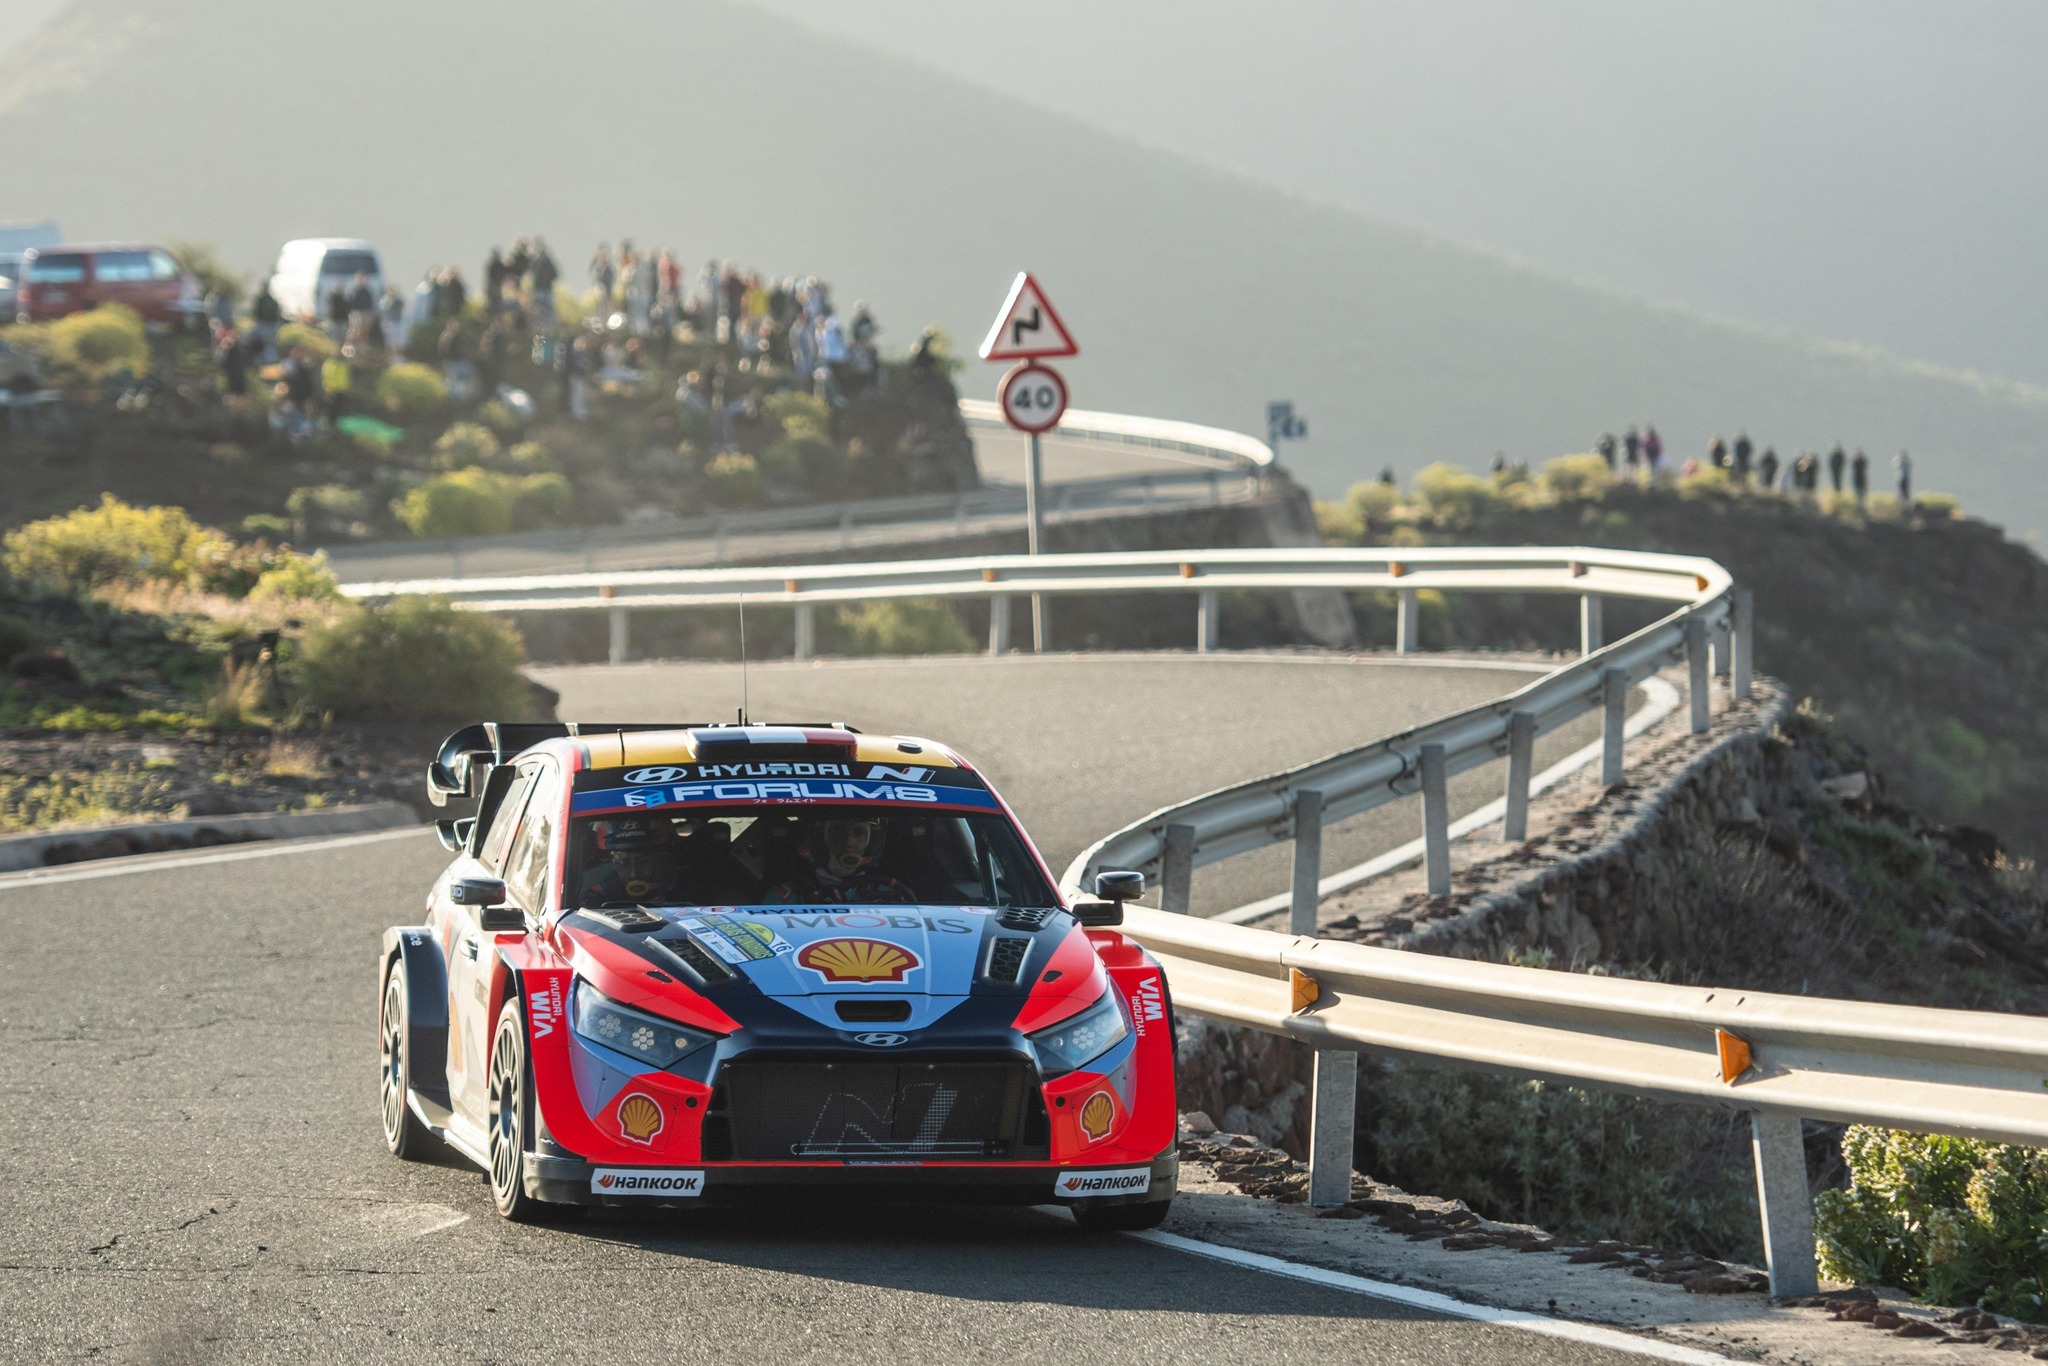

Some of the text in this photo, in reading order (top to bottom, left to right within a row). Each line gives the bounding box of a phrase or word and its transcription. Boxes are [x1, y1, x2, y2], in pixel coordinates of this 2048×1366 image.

[1013, 386, 1056, 409] 40
[698, 763, 851, 778] HYUNDAI
[672, 782, 938, 802] FORUM8
[747, 907, 881, 915] HYUNDAI
[782, 914, 973, 934] MOBIS
[771, 941, 792, 953] 16
[549, 977, 562, 1016] HYUNDAI
[1131, 996, 1146, 1036] HYUNDAI
